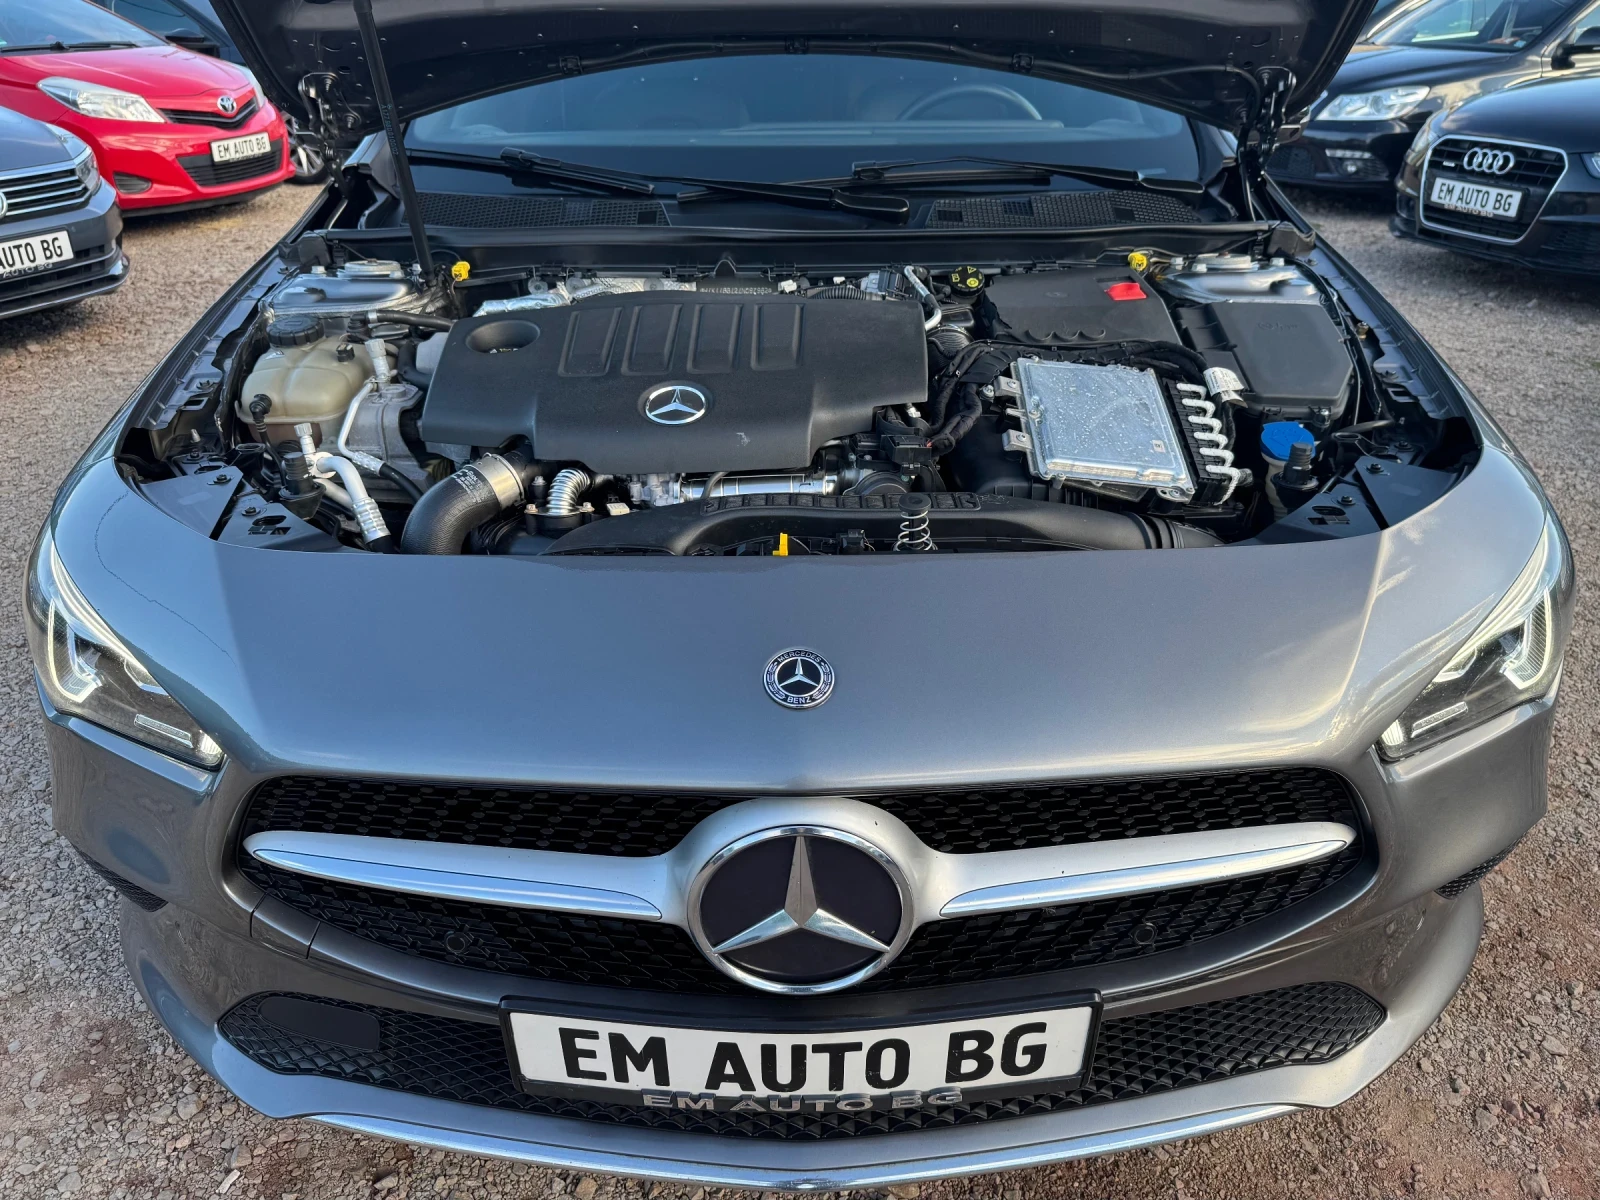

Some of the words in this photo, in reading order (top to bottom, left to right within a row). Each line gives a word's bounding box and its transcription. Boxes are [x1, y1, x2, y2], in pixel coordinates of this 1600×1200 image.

[217, 143, 231, 159] EM
[234, 139, 255, 155] AUTO
[255, 136, 267, 151] BG
[1437, 182, 1455, 201] EM
[1456, 186, 1490, 208] AUTO
[1492, 192, 1513, 213] BG
[40, 236, 63, 261] BG
[3, 266, 34, 279] AUTO
[38, 262, 53, 271] BG
[777, 650, 822, 663] MERCEDES
[786, 696, 812, 704] BENZ
[558, 1027, 671, 1087] EM
[704, 1038, 911, 1093] AUTO
[945, 1021, 1048, 1084] BG
[641, 1089, 716, 1110] EM
[730, 1093, 873, 1112] AUTO
[890, 1087, 963, 1109] BG
